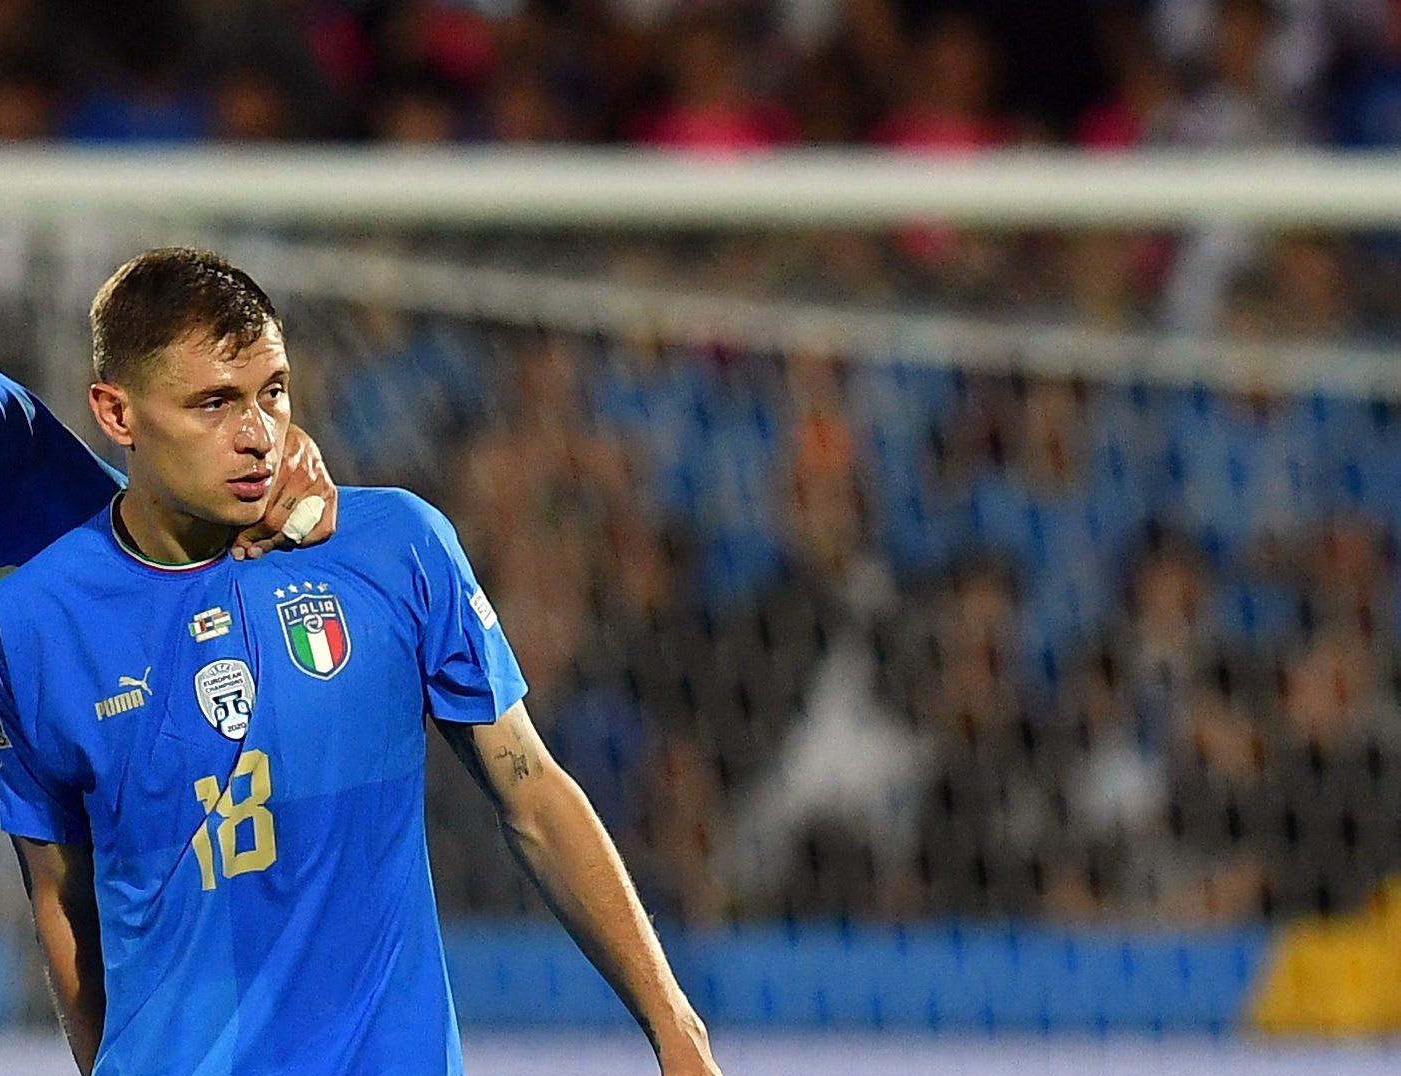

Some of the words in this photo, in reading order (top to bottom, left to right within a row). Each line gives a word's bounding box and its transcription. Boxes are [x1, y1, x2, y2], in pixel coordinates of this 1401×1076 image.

[284, 600, 335, 620] ITALIA
[203, 672, 242, 687] EUROPEAN
[95, 688, 145, 721] PUMA
[227, 722, 248, 733] 2020
[192, 748, 277, 891] 18
